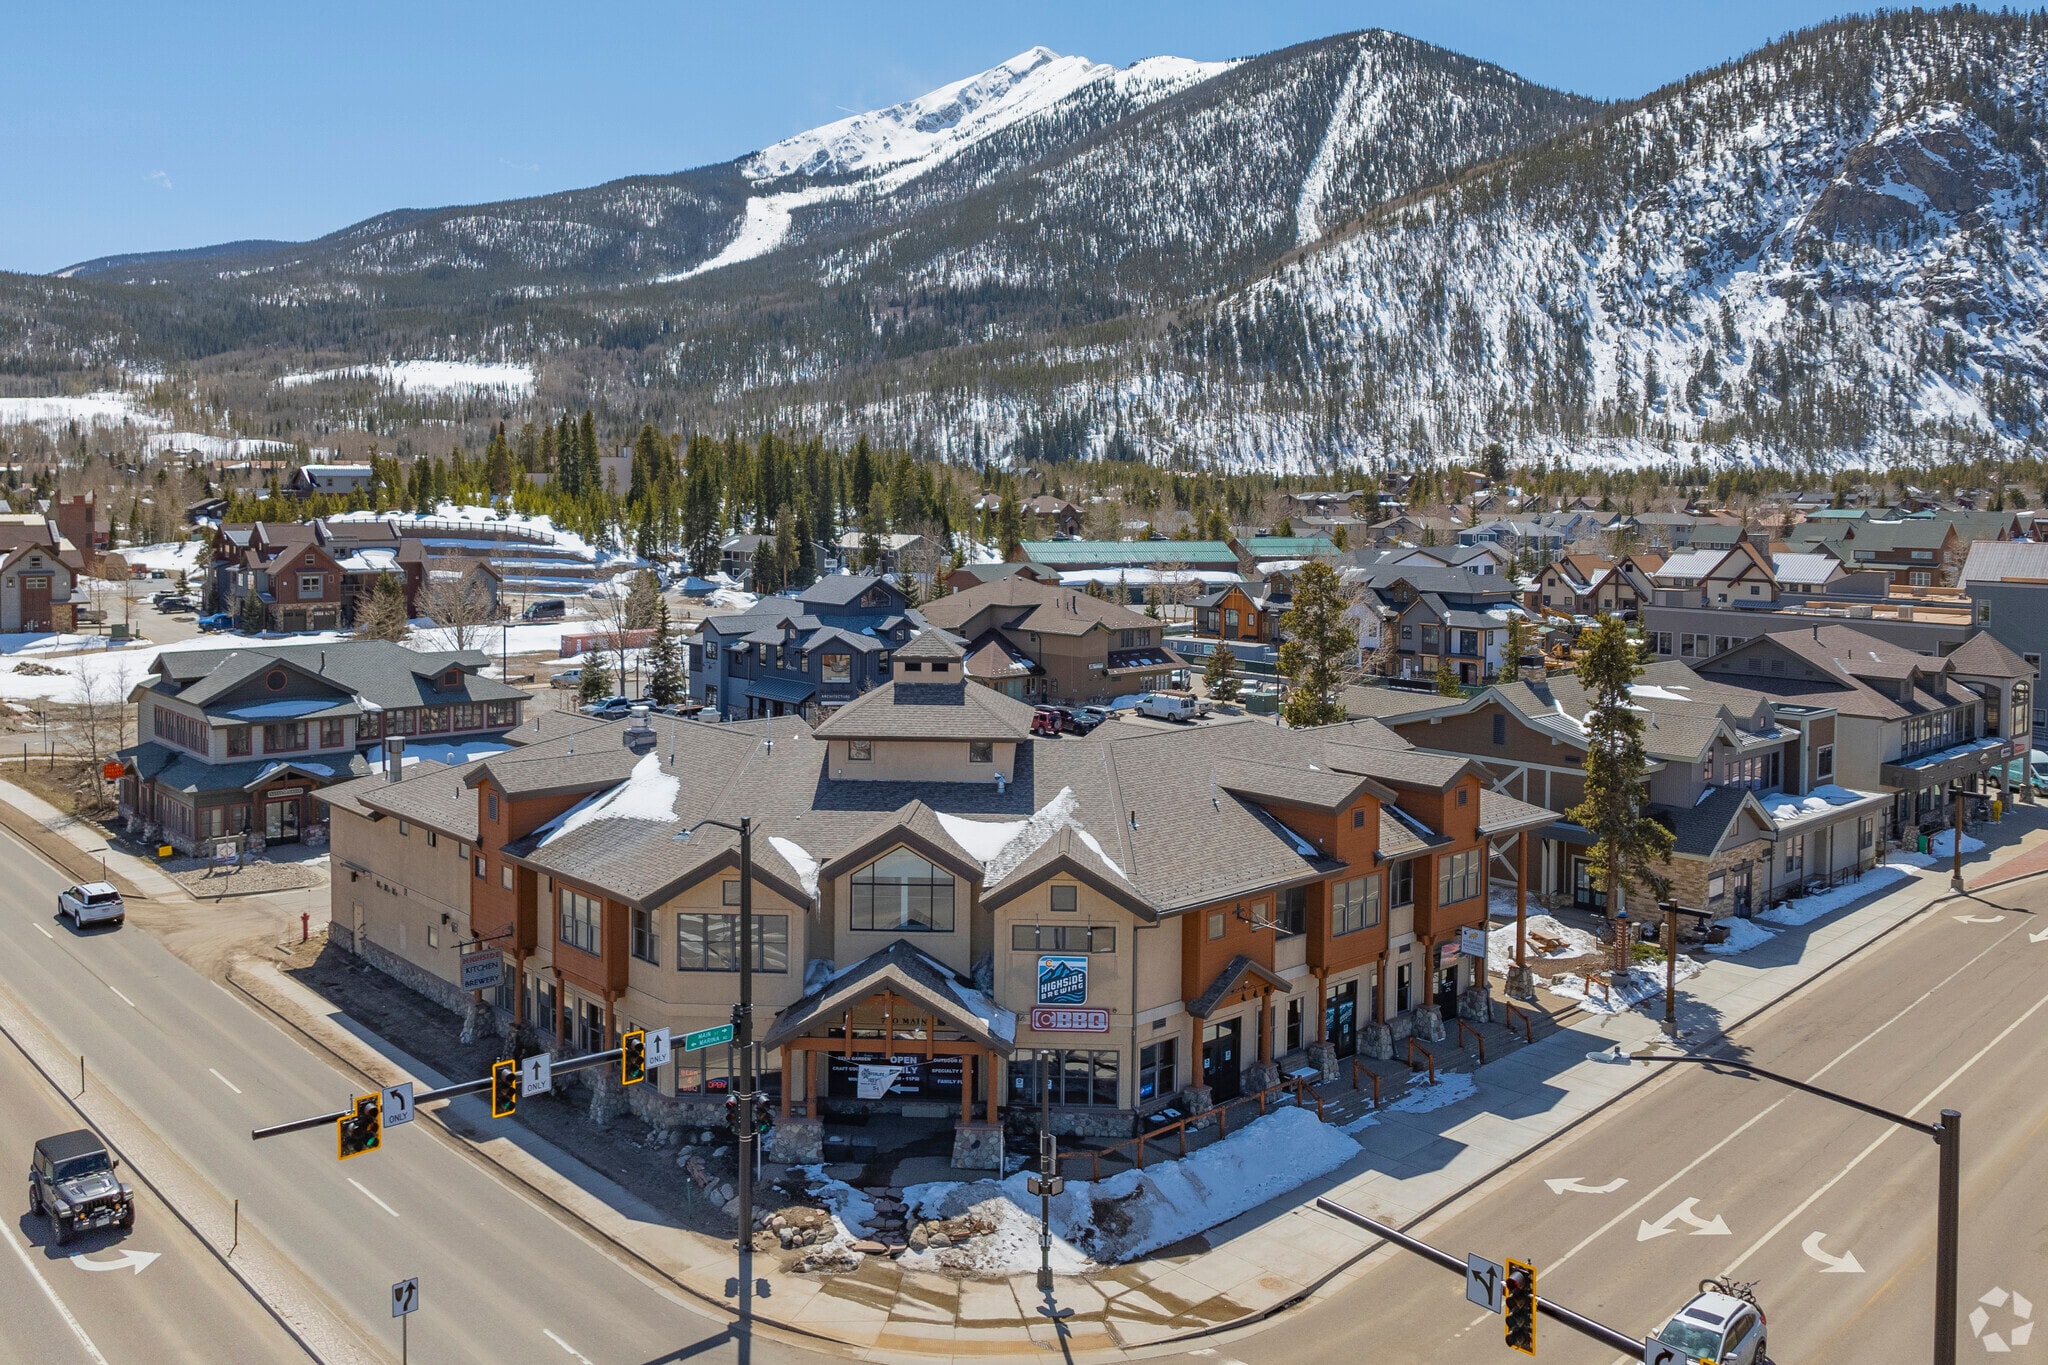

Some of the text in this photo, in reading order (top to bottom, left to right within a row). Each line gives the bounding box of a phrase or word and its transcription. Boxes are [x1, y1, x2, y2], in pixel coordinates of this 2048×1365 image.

[463, 951, 501, 964] HIGHSIDE
[466, 962, 498, 973] KITCHEN
[465, 976, 499, 987] BREWERY
[1041, 973, 1084, 993] HIGHSIDE
[1041, 982, 1084, 999] BREWING
[903, 1017, 927, 1025] MAIN
[698, 1031, 711, 1039] MAIN
[700, 1036, 719, 1045] MARINA
[650, 1054, 666, 1064] ONLY
[890, 1056, 917, 1064] OPEN
[527, 1081, 546, 1092] ONLY
[389, 1112, 408, 1124] ONLY
